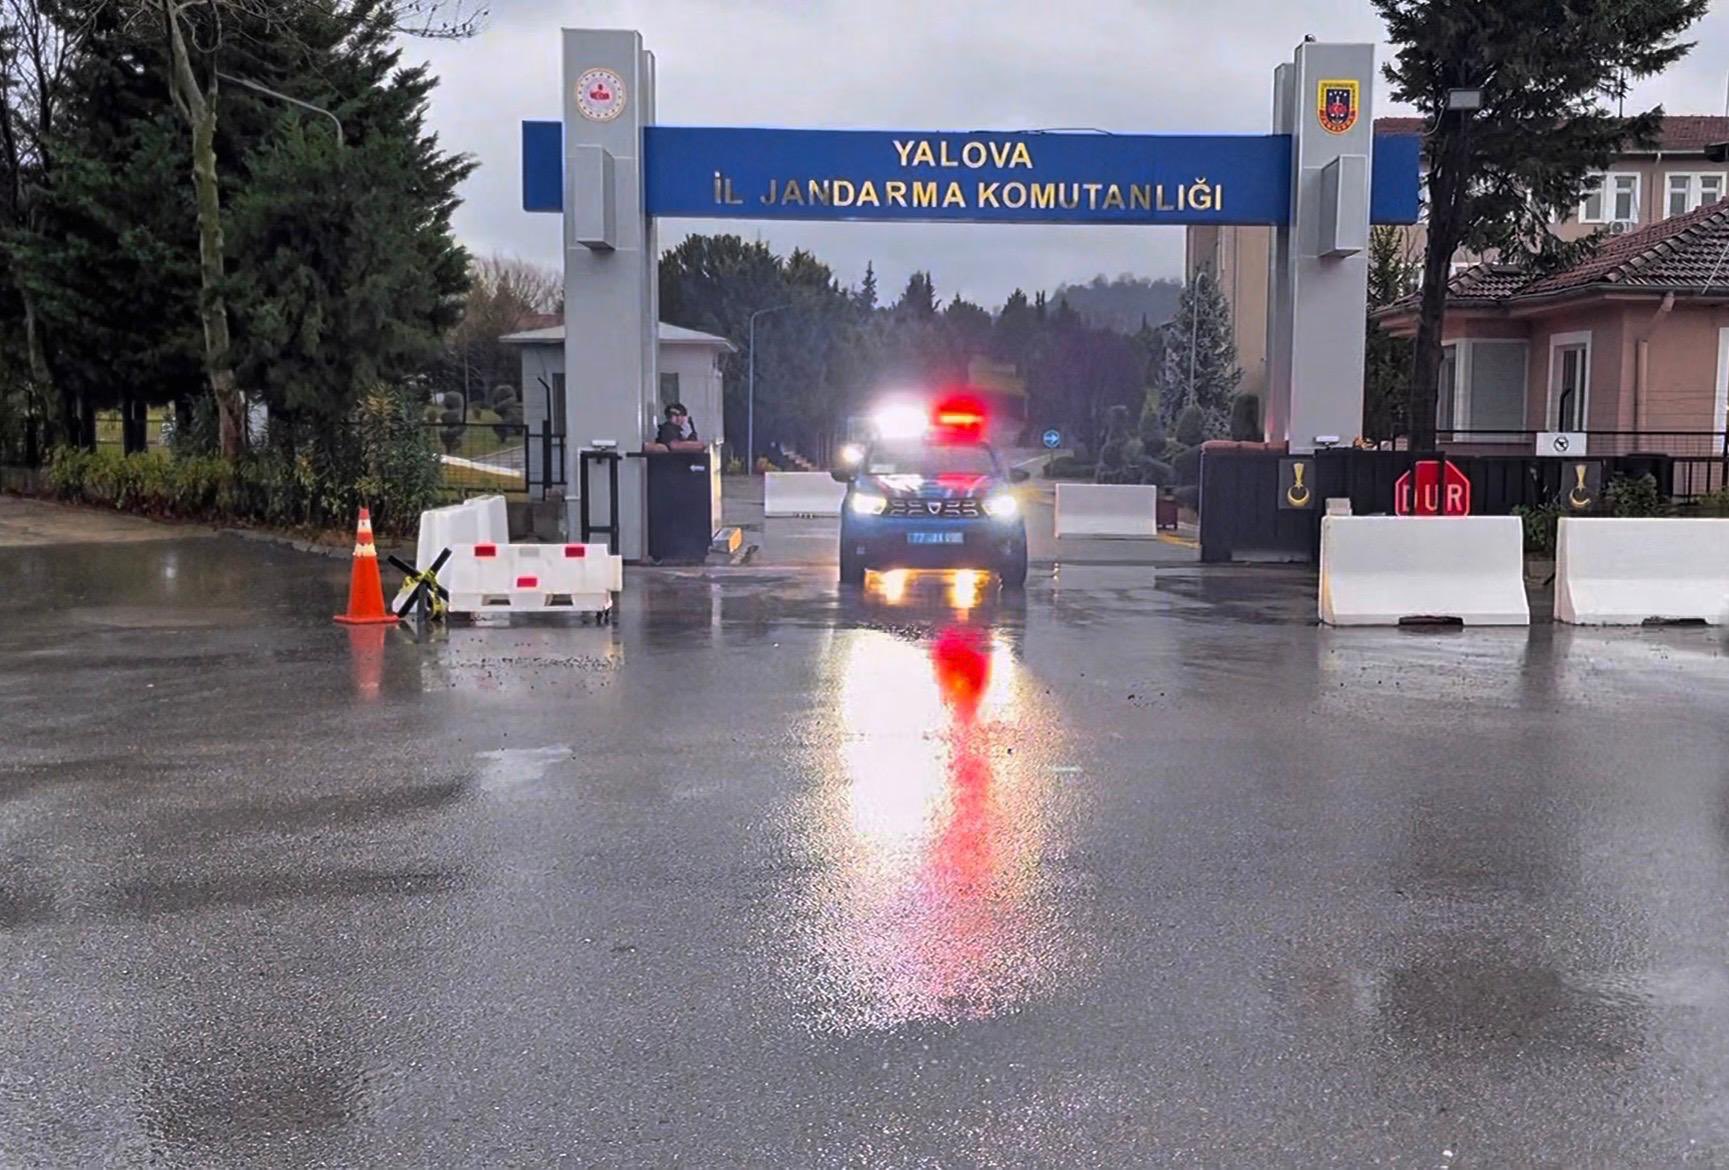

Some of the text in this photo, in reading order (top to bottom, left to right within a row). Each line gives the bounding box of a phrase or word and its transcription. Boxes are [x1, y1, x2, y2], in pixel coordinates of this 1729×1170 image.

[892, 140, 1033, 169] YALOVA
[714, 171, 1222, 211] İL JANDARMA KOMUTANLIĞI
